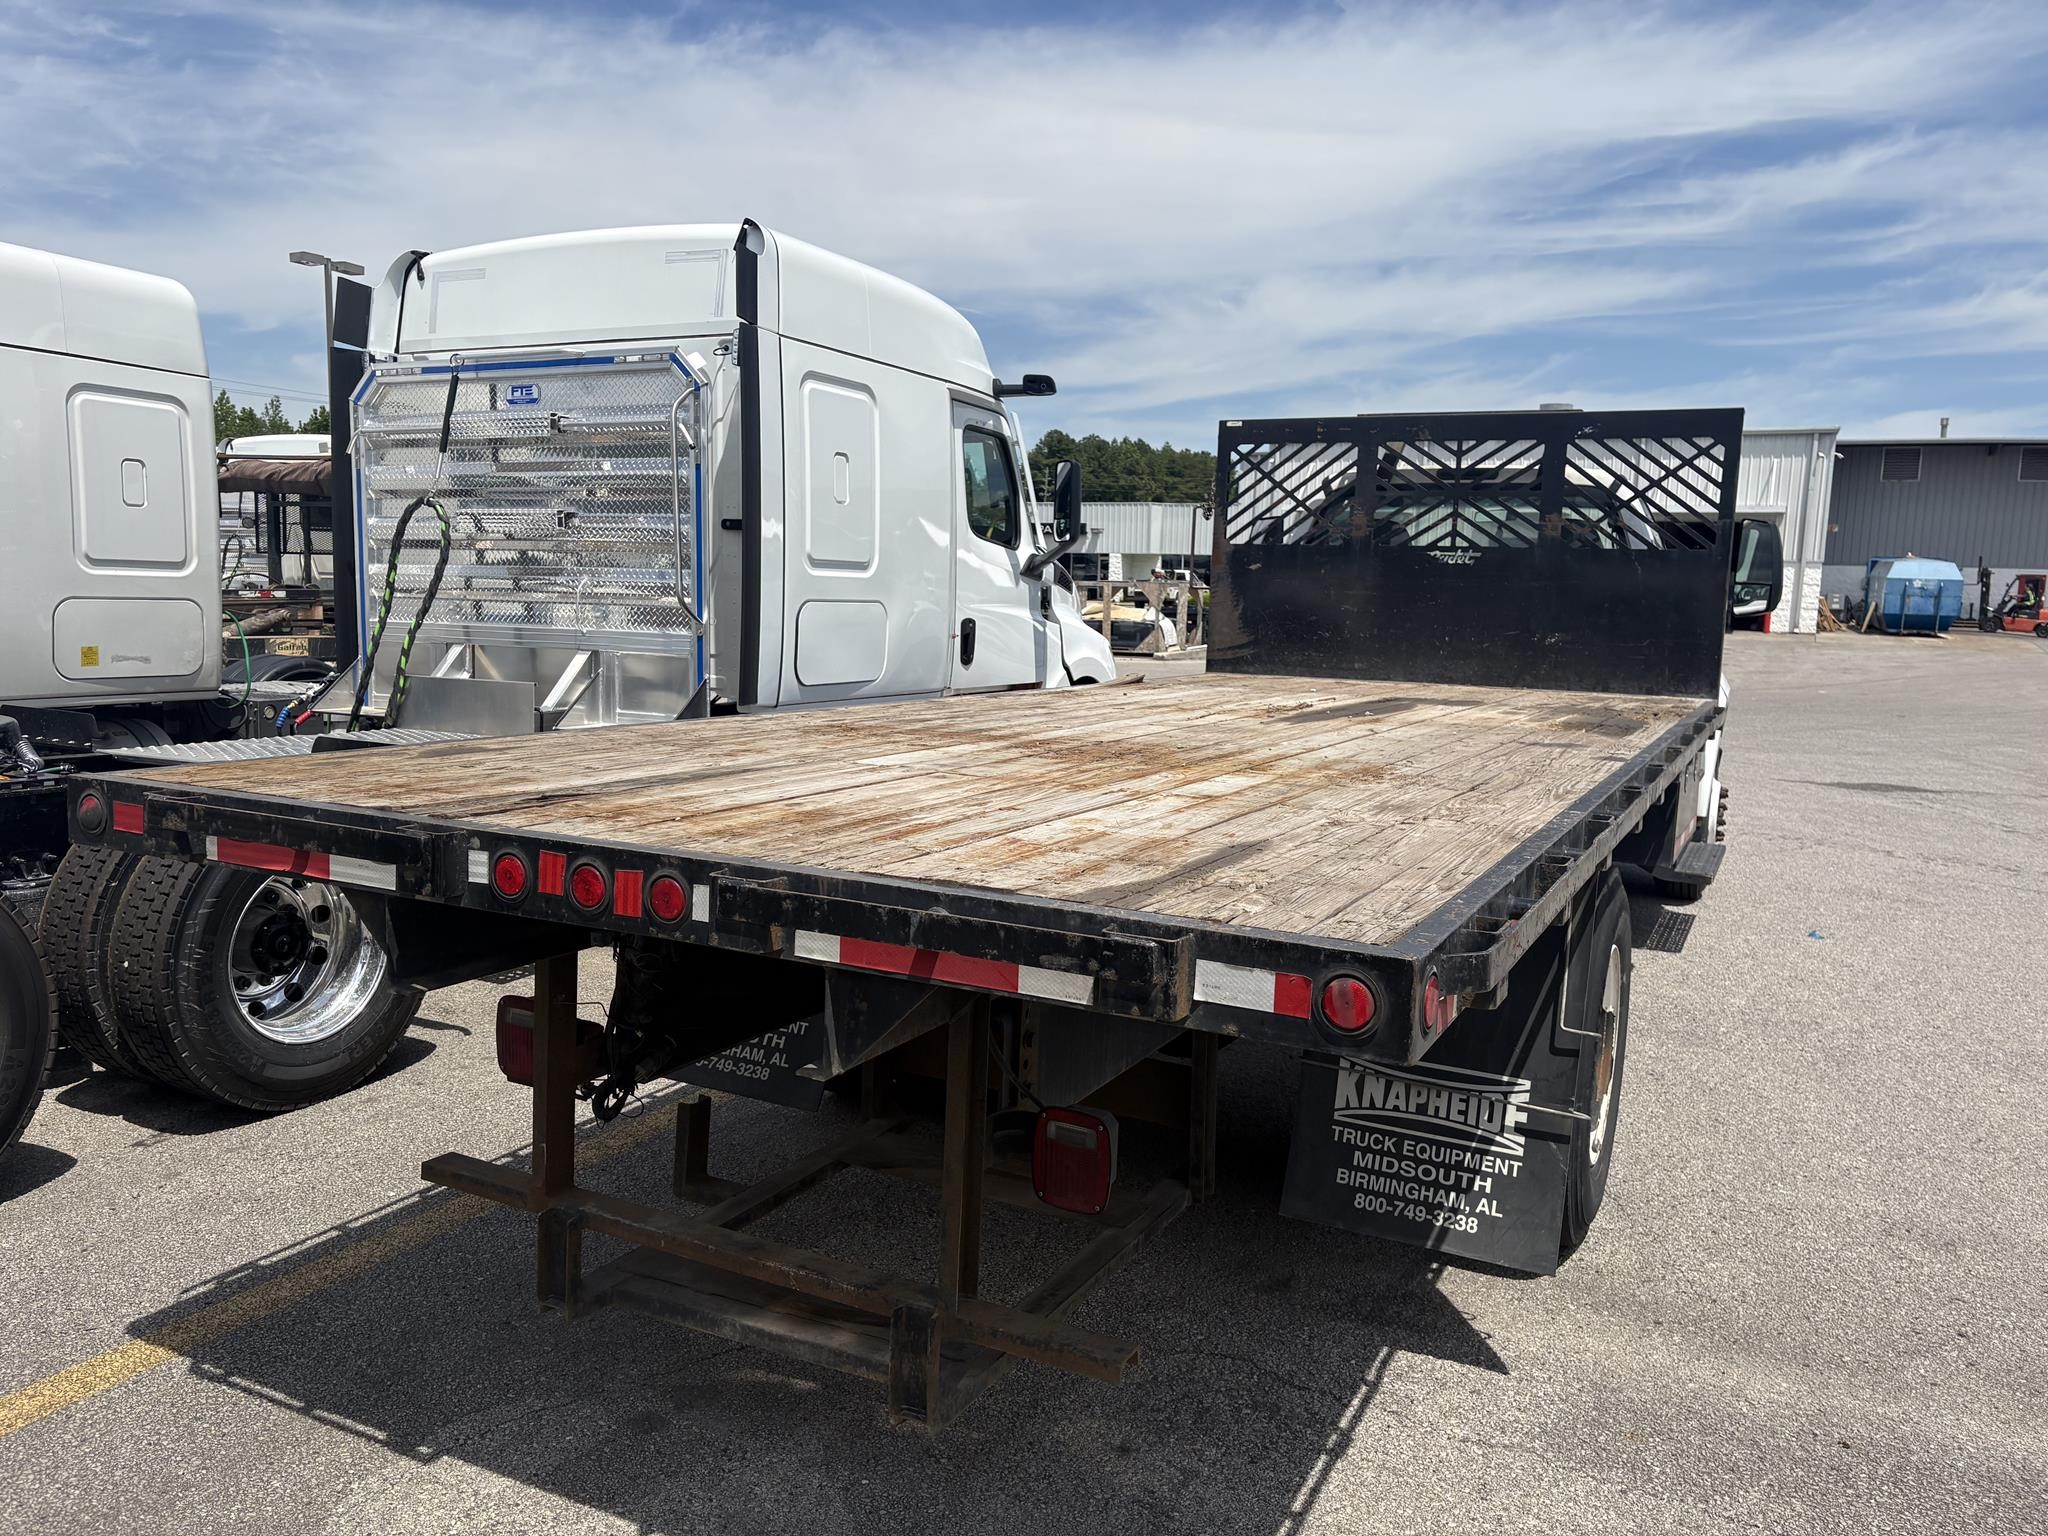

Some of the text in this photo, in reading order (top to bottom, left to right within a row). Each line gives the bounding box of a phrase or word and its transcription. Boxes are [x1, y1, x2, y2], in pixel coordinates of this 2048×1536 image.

[695, 1056, 771, 1081] -749-3238
[769, 1051, 789, 1068] AL
[1334, 1056, 1531, 1146] KNAPHEIDE
[1331, 1125, 1523, 1178] TRUCK EQUIPMENT
[1352, 1150, 1493, 1194] MIDSOUTH
[1335, 1167, 1504, 1218] BIRMINGHAM, AL
[1353, 1192, 1479, 1234] 800-749-3238
